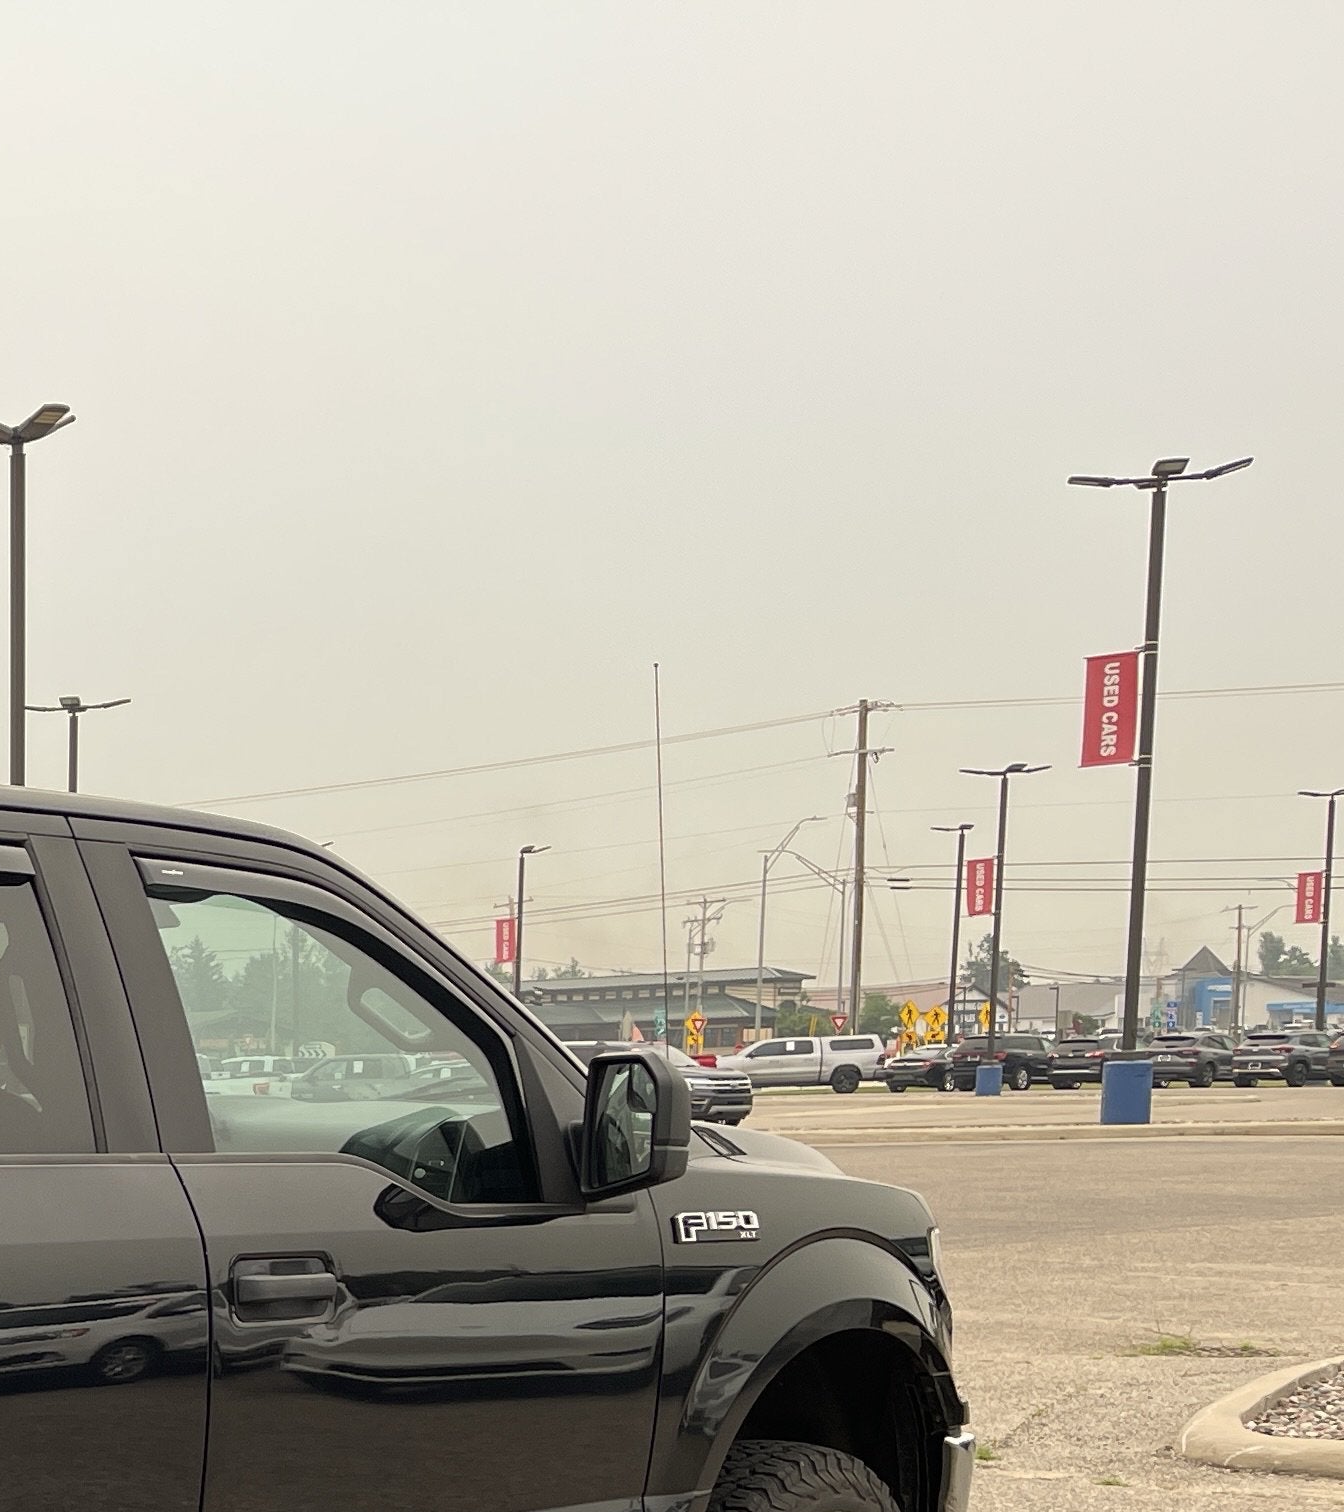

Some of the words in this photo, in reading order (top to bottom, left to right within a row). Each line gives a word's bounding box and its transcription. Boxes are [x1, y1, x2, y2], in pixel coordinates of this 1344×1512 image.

[1102, 661, 1121, 708] USED
[1099, 711, 1119, 757] CARS
[975, 862, 985, 887] USED
[1305, 875, 1315, 898] USED
[974, 887, 984, 912] CARS
[1304, 898, 1313, 920] CARS
[739, 1230, 757, 1239] XLT
